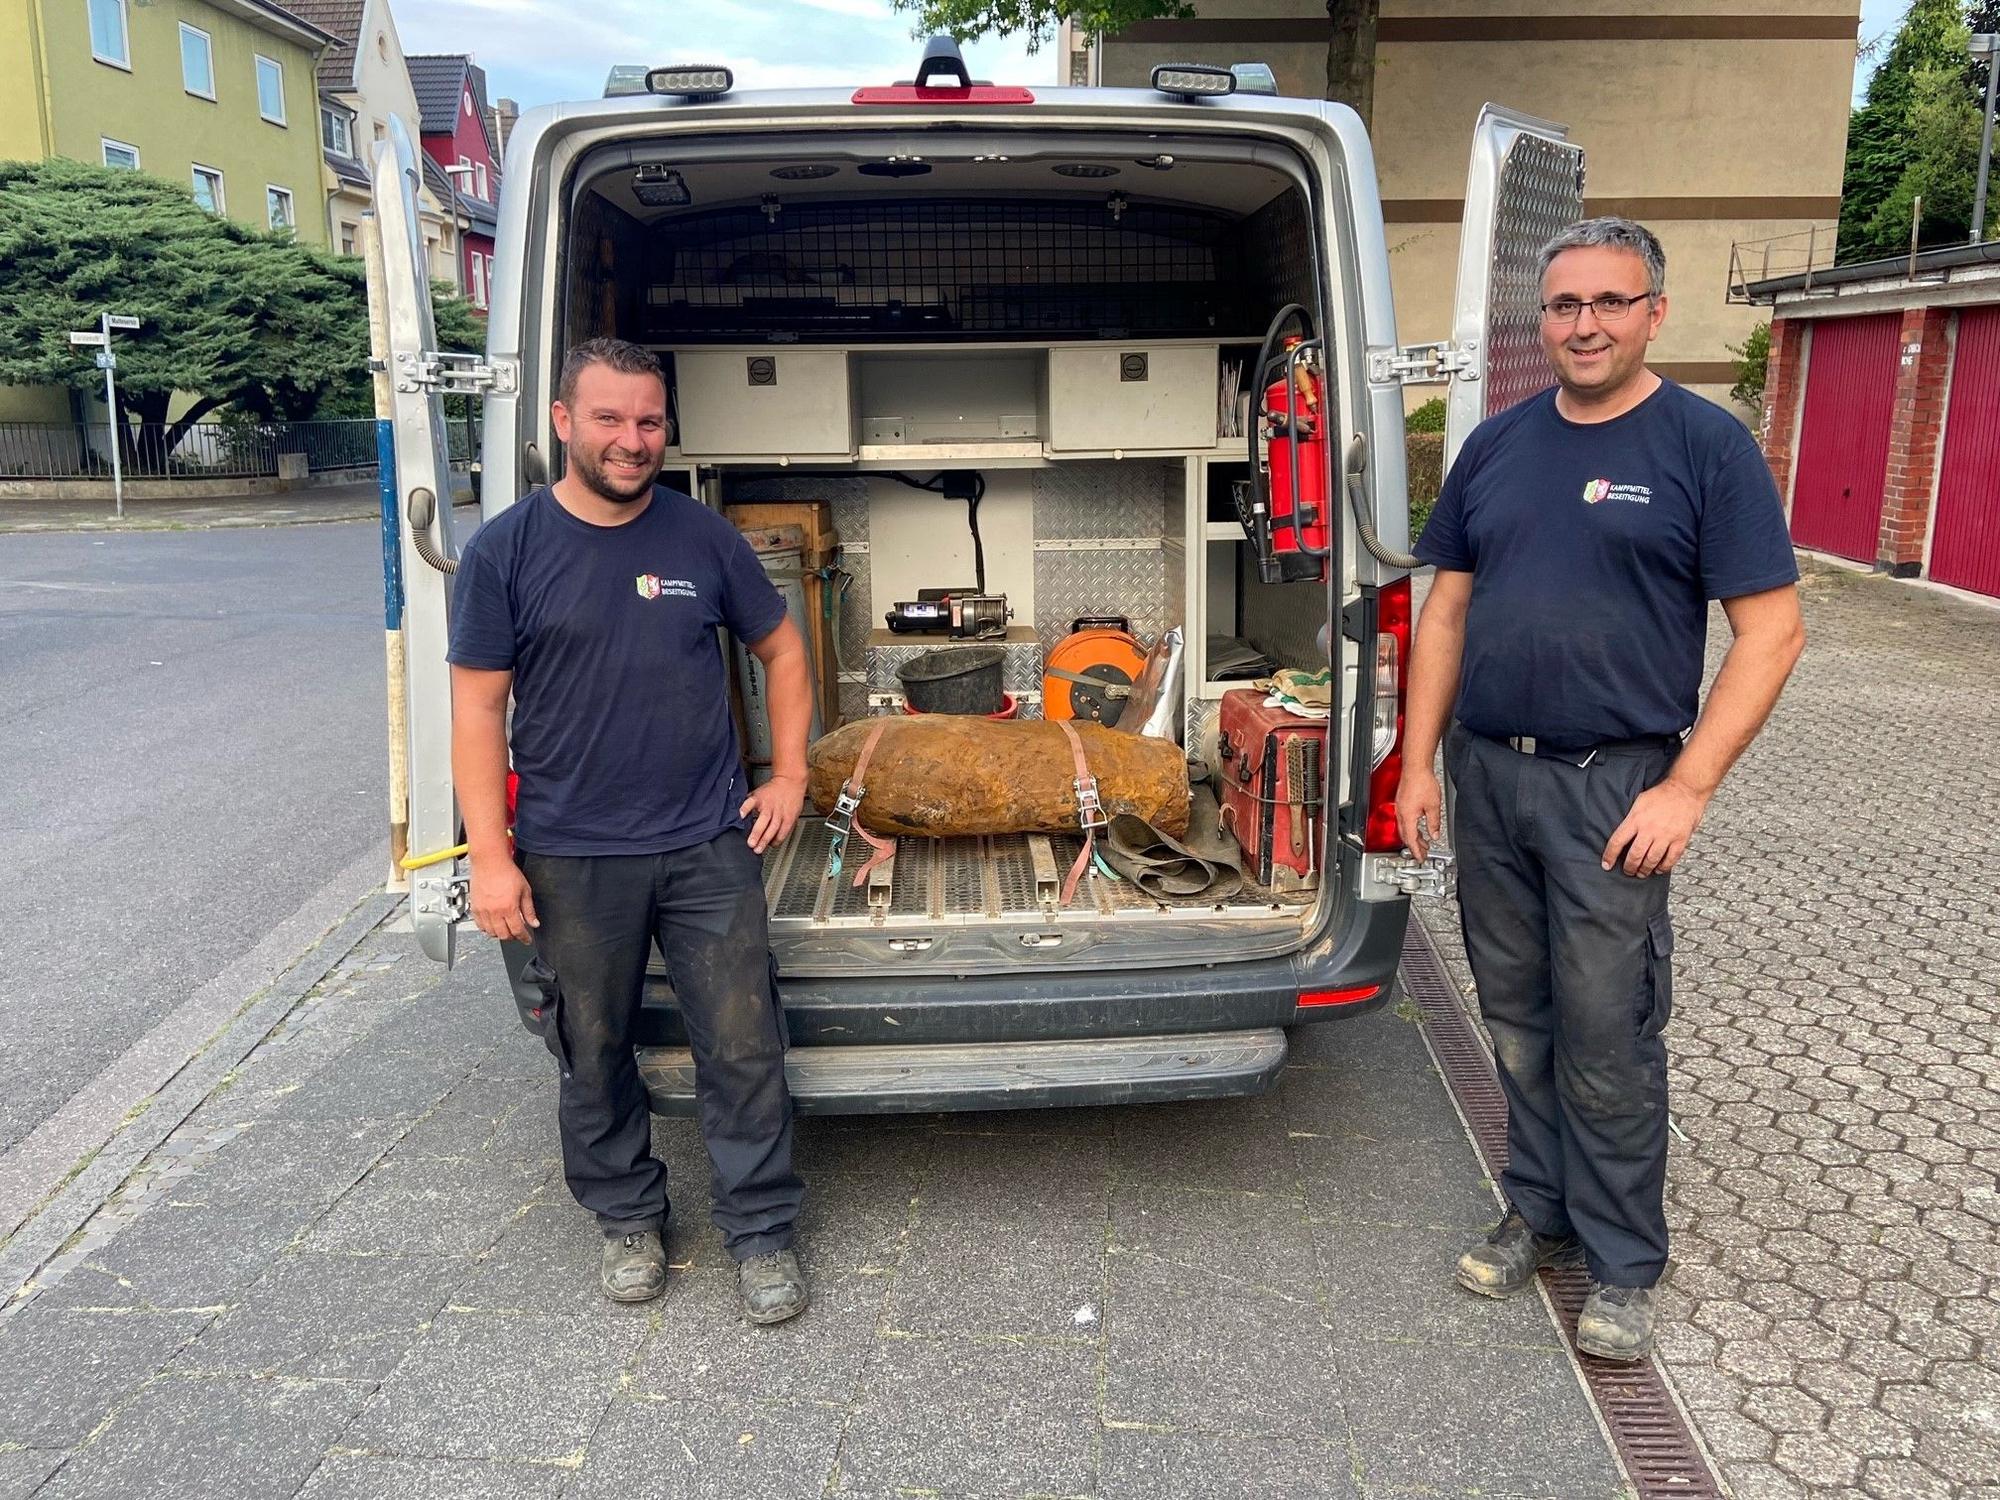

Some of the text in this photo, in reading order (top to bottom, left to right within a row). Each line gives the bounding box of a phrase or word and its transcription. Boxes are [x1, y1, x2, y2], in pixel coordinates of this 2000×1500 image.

[1610, 485, 1653, 495] KAMPFMITTEL-
[1607, 493, 1650, 504] BESEITIGUNG
[660, 580, 696, 588] KAMPFMITTEL-
[662, 588, 697, 597] BESEITIGUNG
